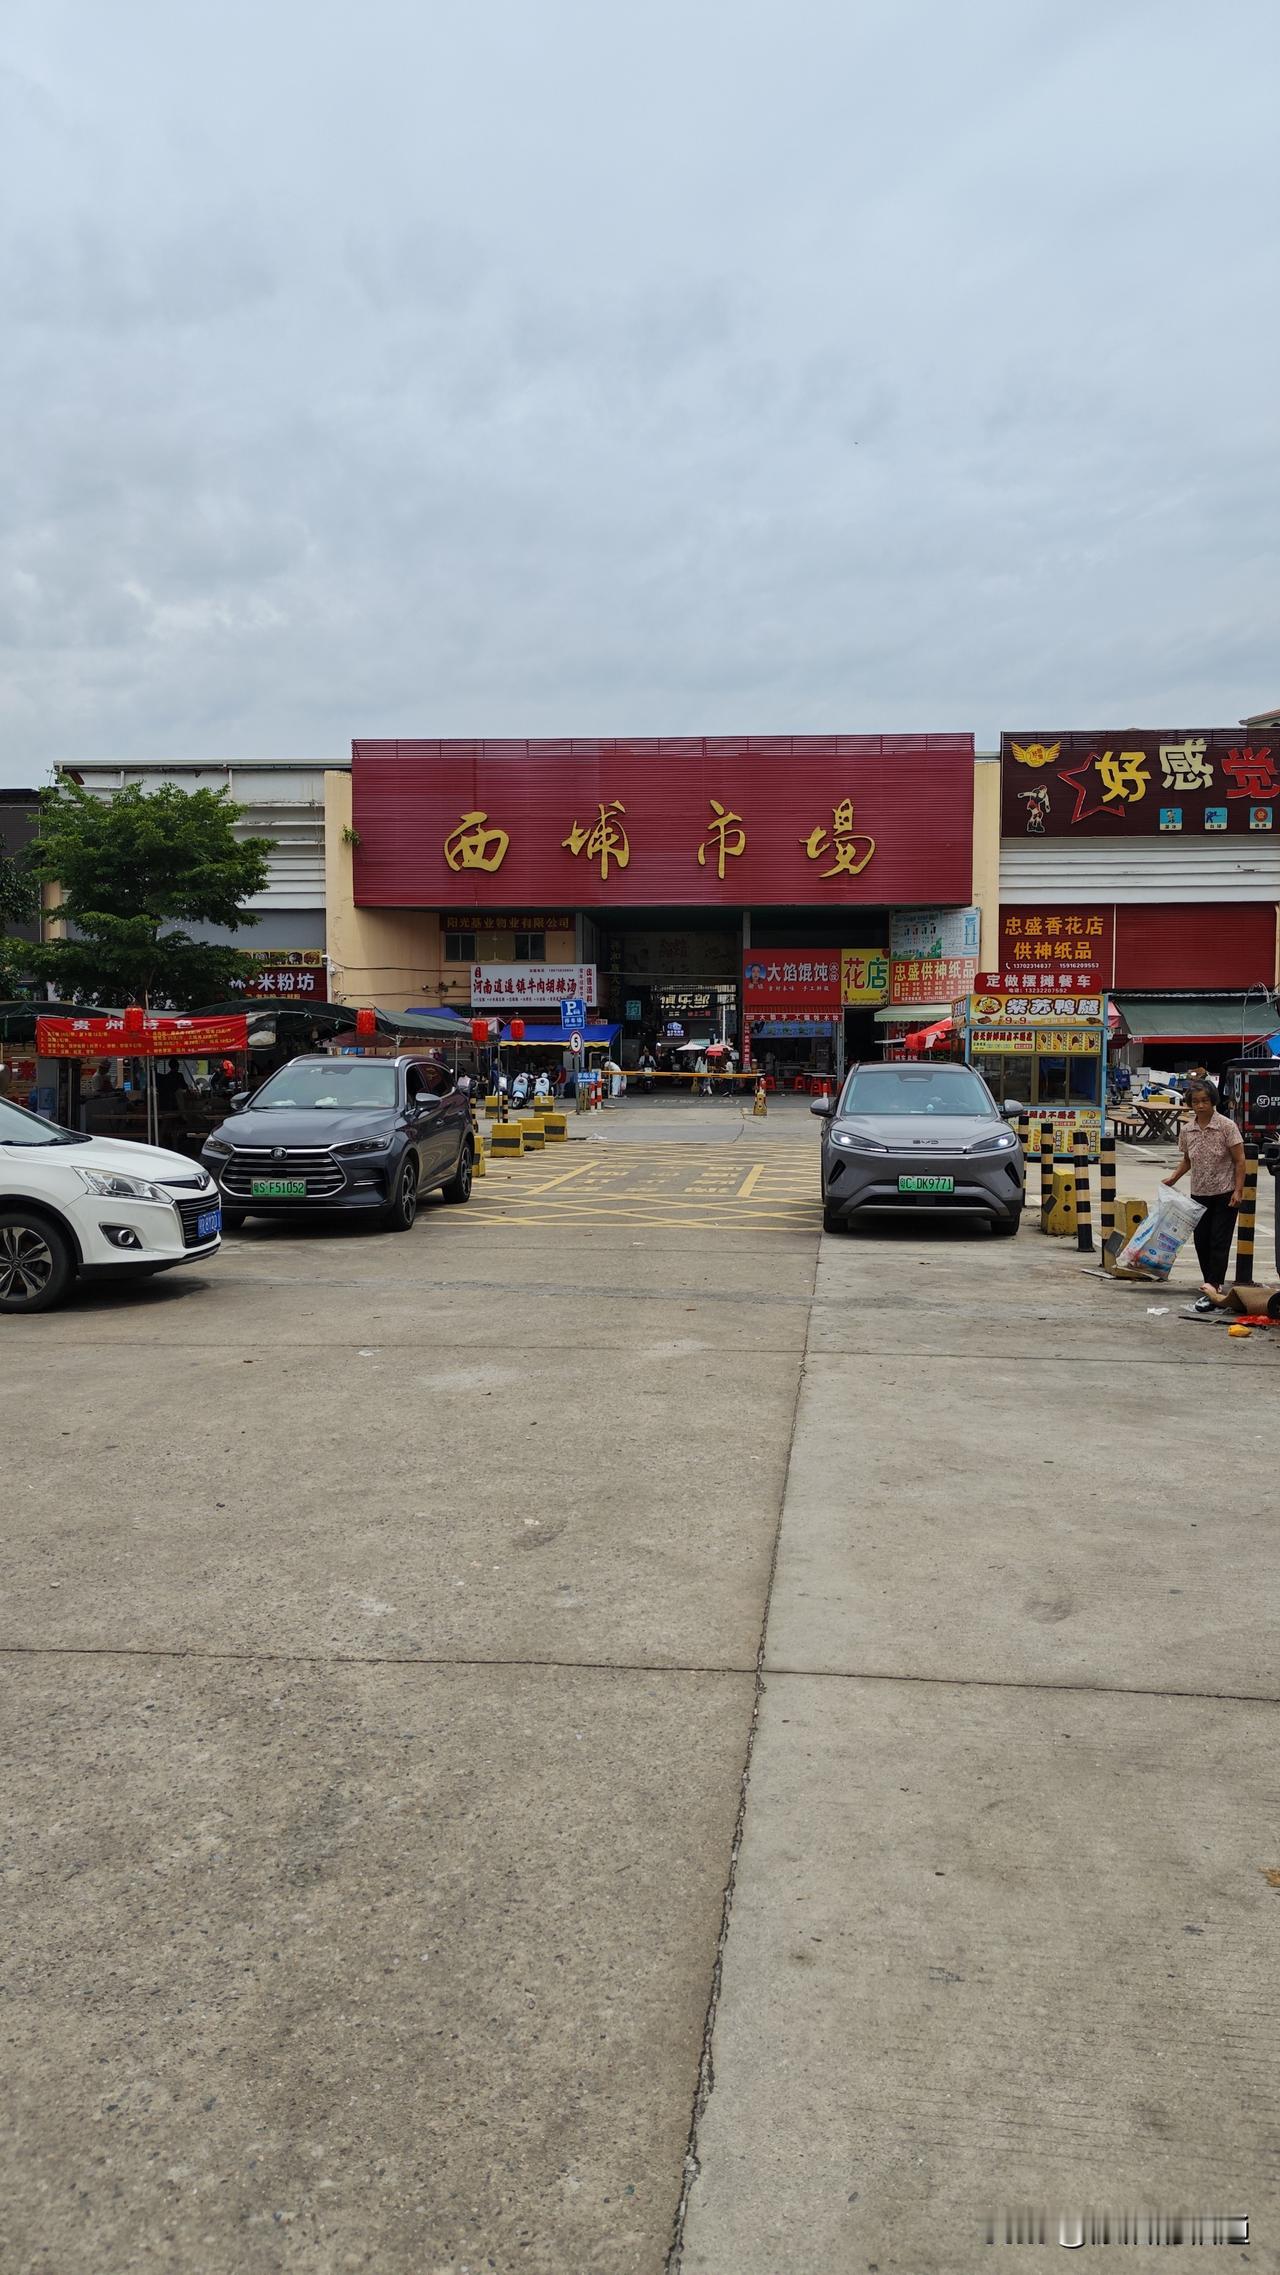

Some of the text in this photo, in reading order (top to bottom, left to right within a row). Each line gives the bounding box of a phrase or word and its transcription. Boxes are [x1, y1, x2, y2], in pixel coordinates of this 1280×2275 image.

[1095, 738, 1280, 802] 好感觉
[447, 917, 570, 929] 阳光基业物业有限公司
[1005, 916, 1103, 936] 忠盛香花店
[1014, 941, 1092, 960] 供神纸品
[767, 962, 828, 982] 大馅馄饨
[843, 957, 888, 989] 花店
[895, 960, 975, 981] 忠盛供神纸品
[473, 977, 577, 994] 河南逍遥镇牛肉胡辣汤
[986, 974, 1091, 987] 定做摆摊餐车
[565, 1001, 576, 1015] P
[1006, 999, 1100, 1014] 紫苏鸭腿
[573, 1036, 579, 1047] 5
